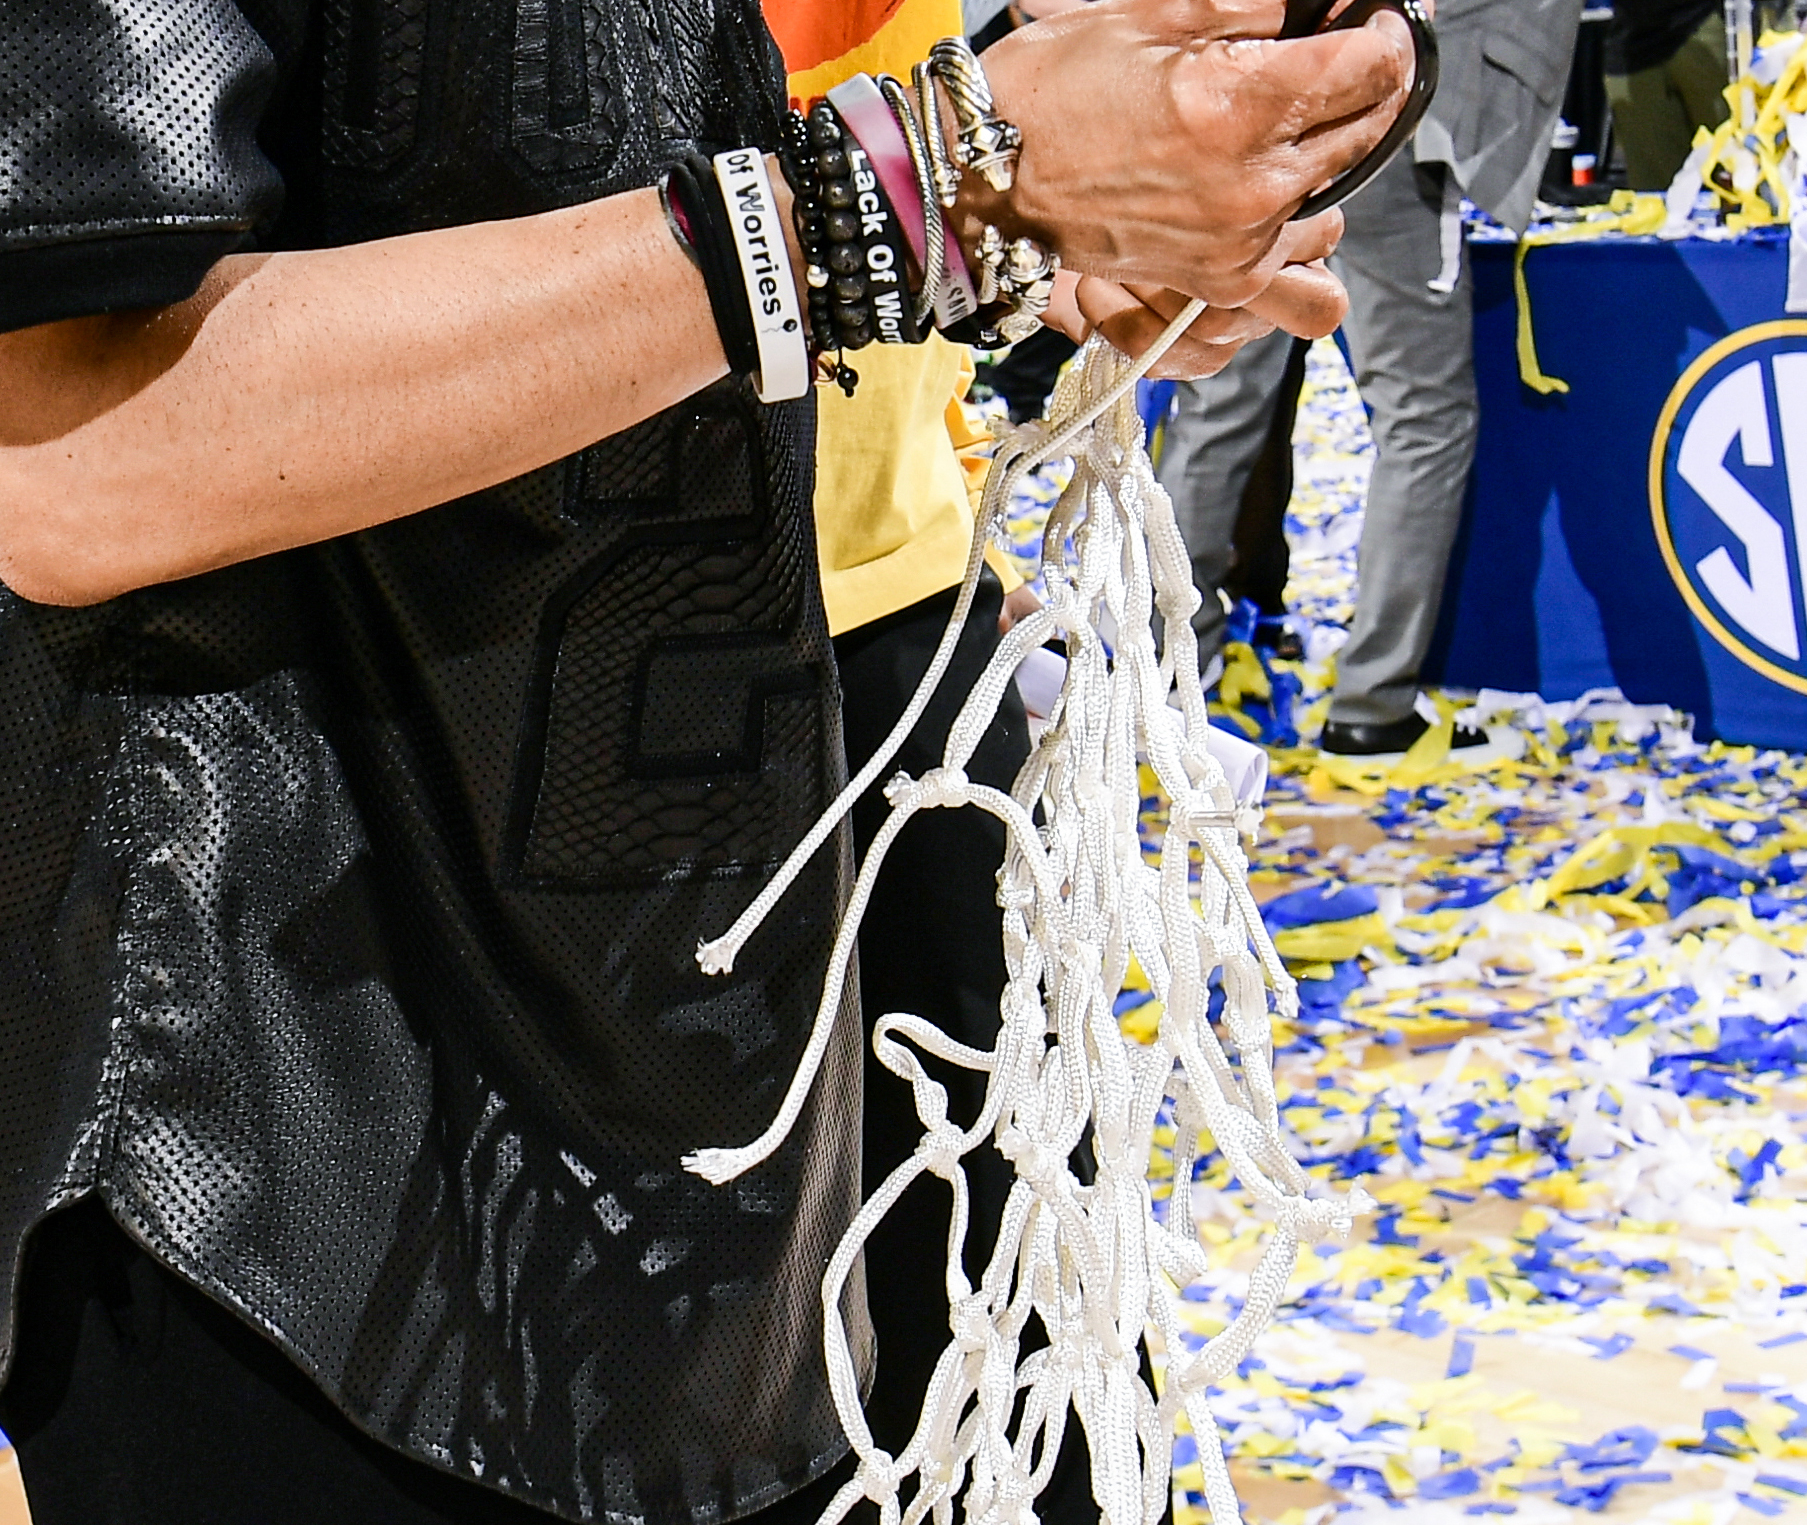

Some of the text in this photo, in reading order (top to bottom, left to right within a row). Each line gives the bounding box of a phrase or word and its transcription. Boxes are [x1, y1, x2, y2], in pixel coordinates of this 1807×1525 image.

[850, 148, 889, 237] Lack
[735, 181, 783, 317] Worries
[866, 243, 898, 284] Of
